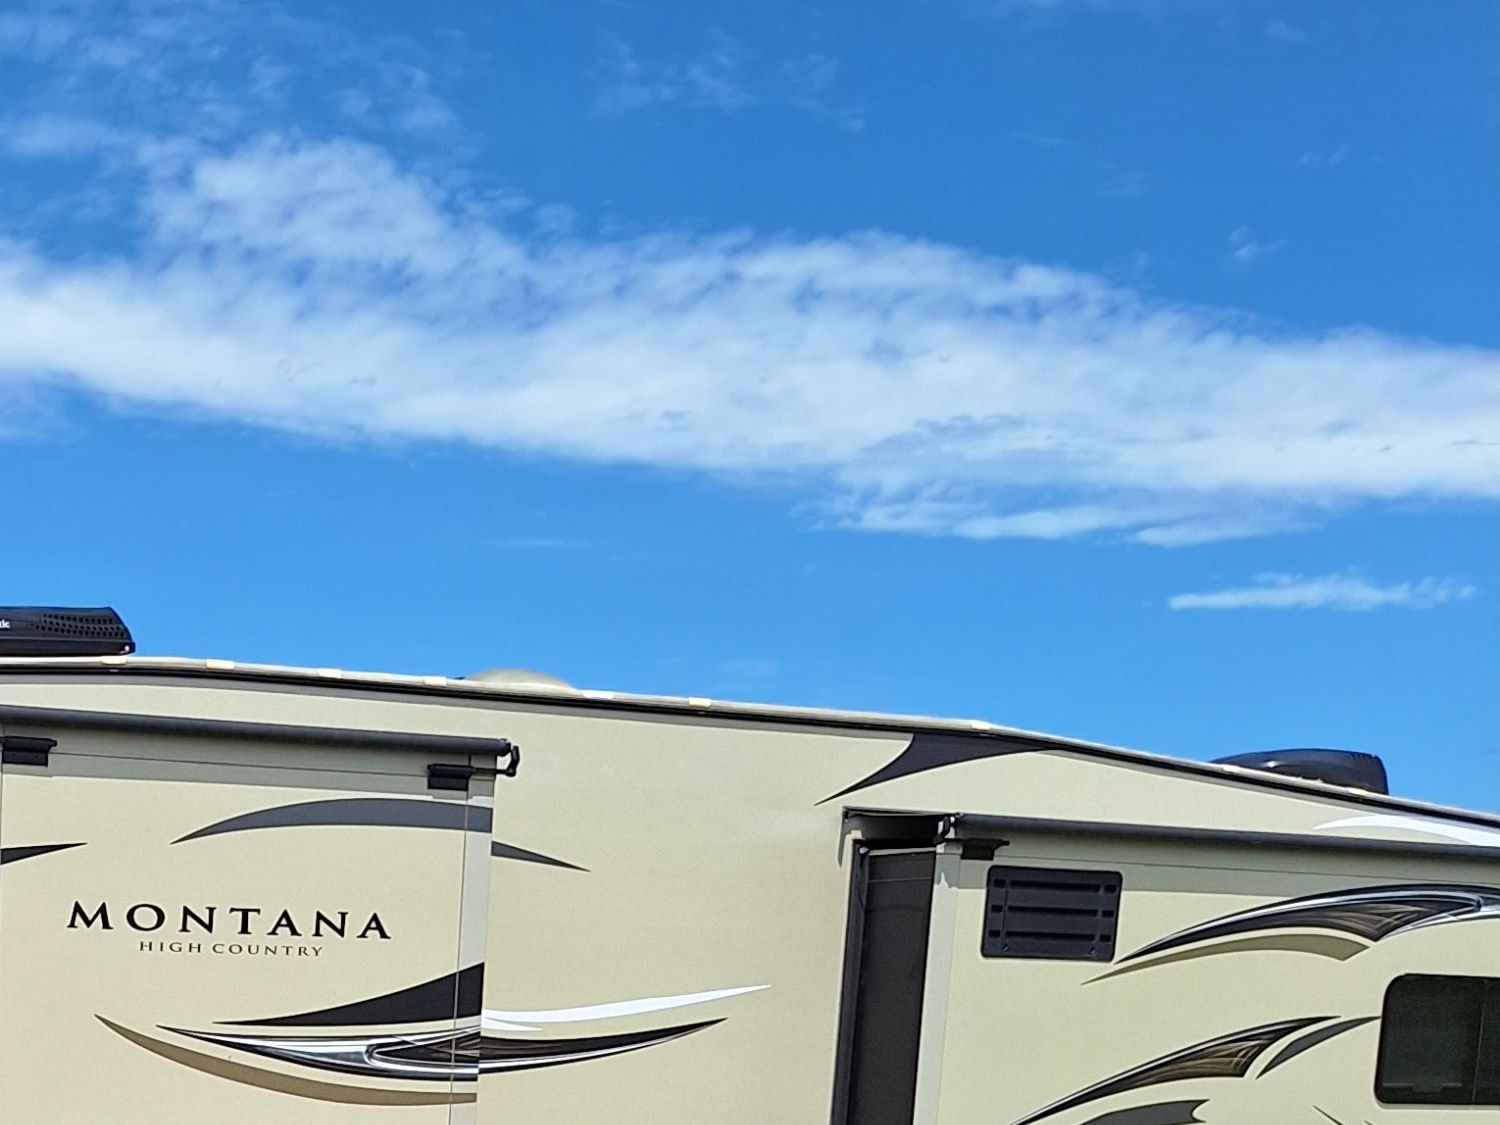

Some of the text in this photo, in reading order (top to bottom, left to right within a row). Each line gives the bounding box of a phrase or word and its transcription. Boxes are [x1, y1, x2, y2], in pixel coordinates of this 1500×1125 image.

[66, 900, 392, 940] MONTANA
[139, 940, 323, 957] HIGH COUNTRY
